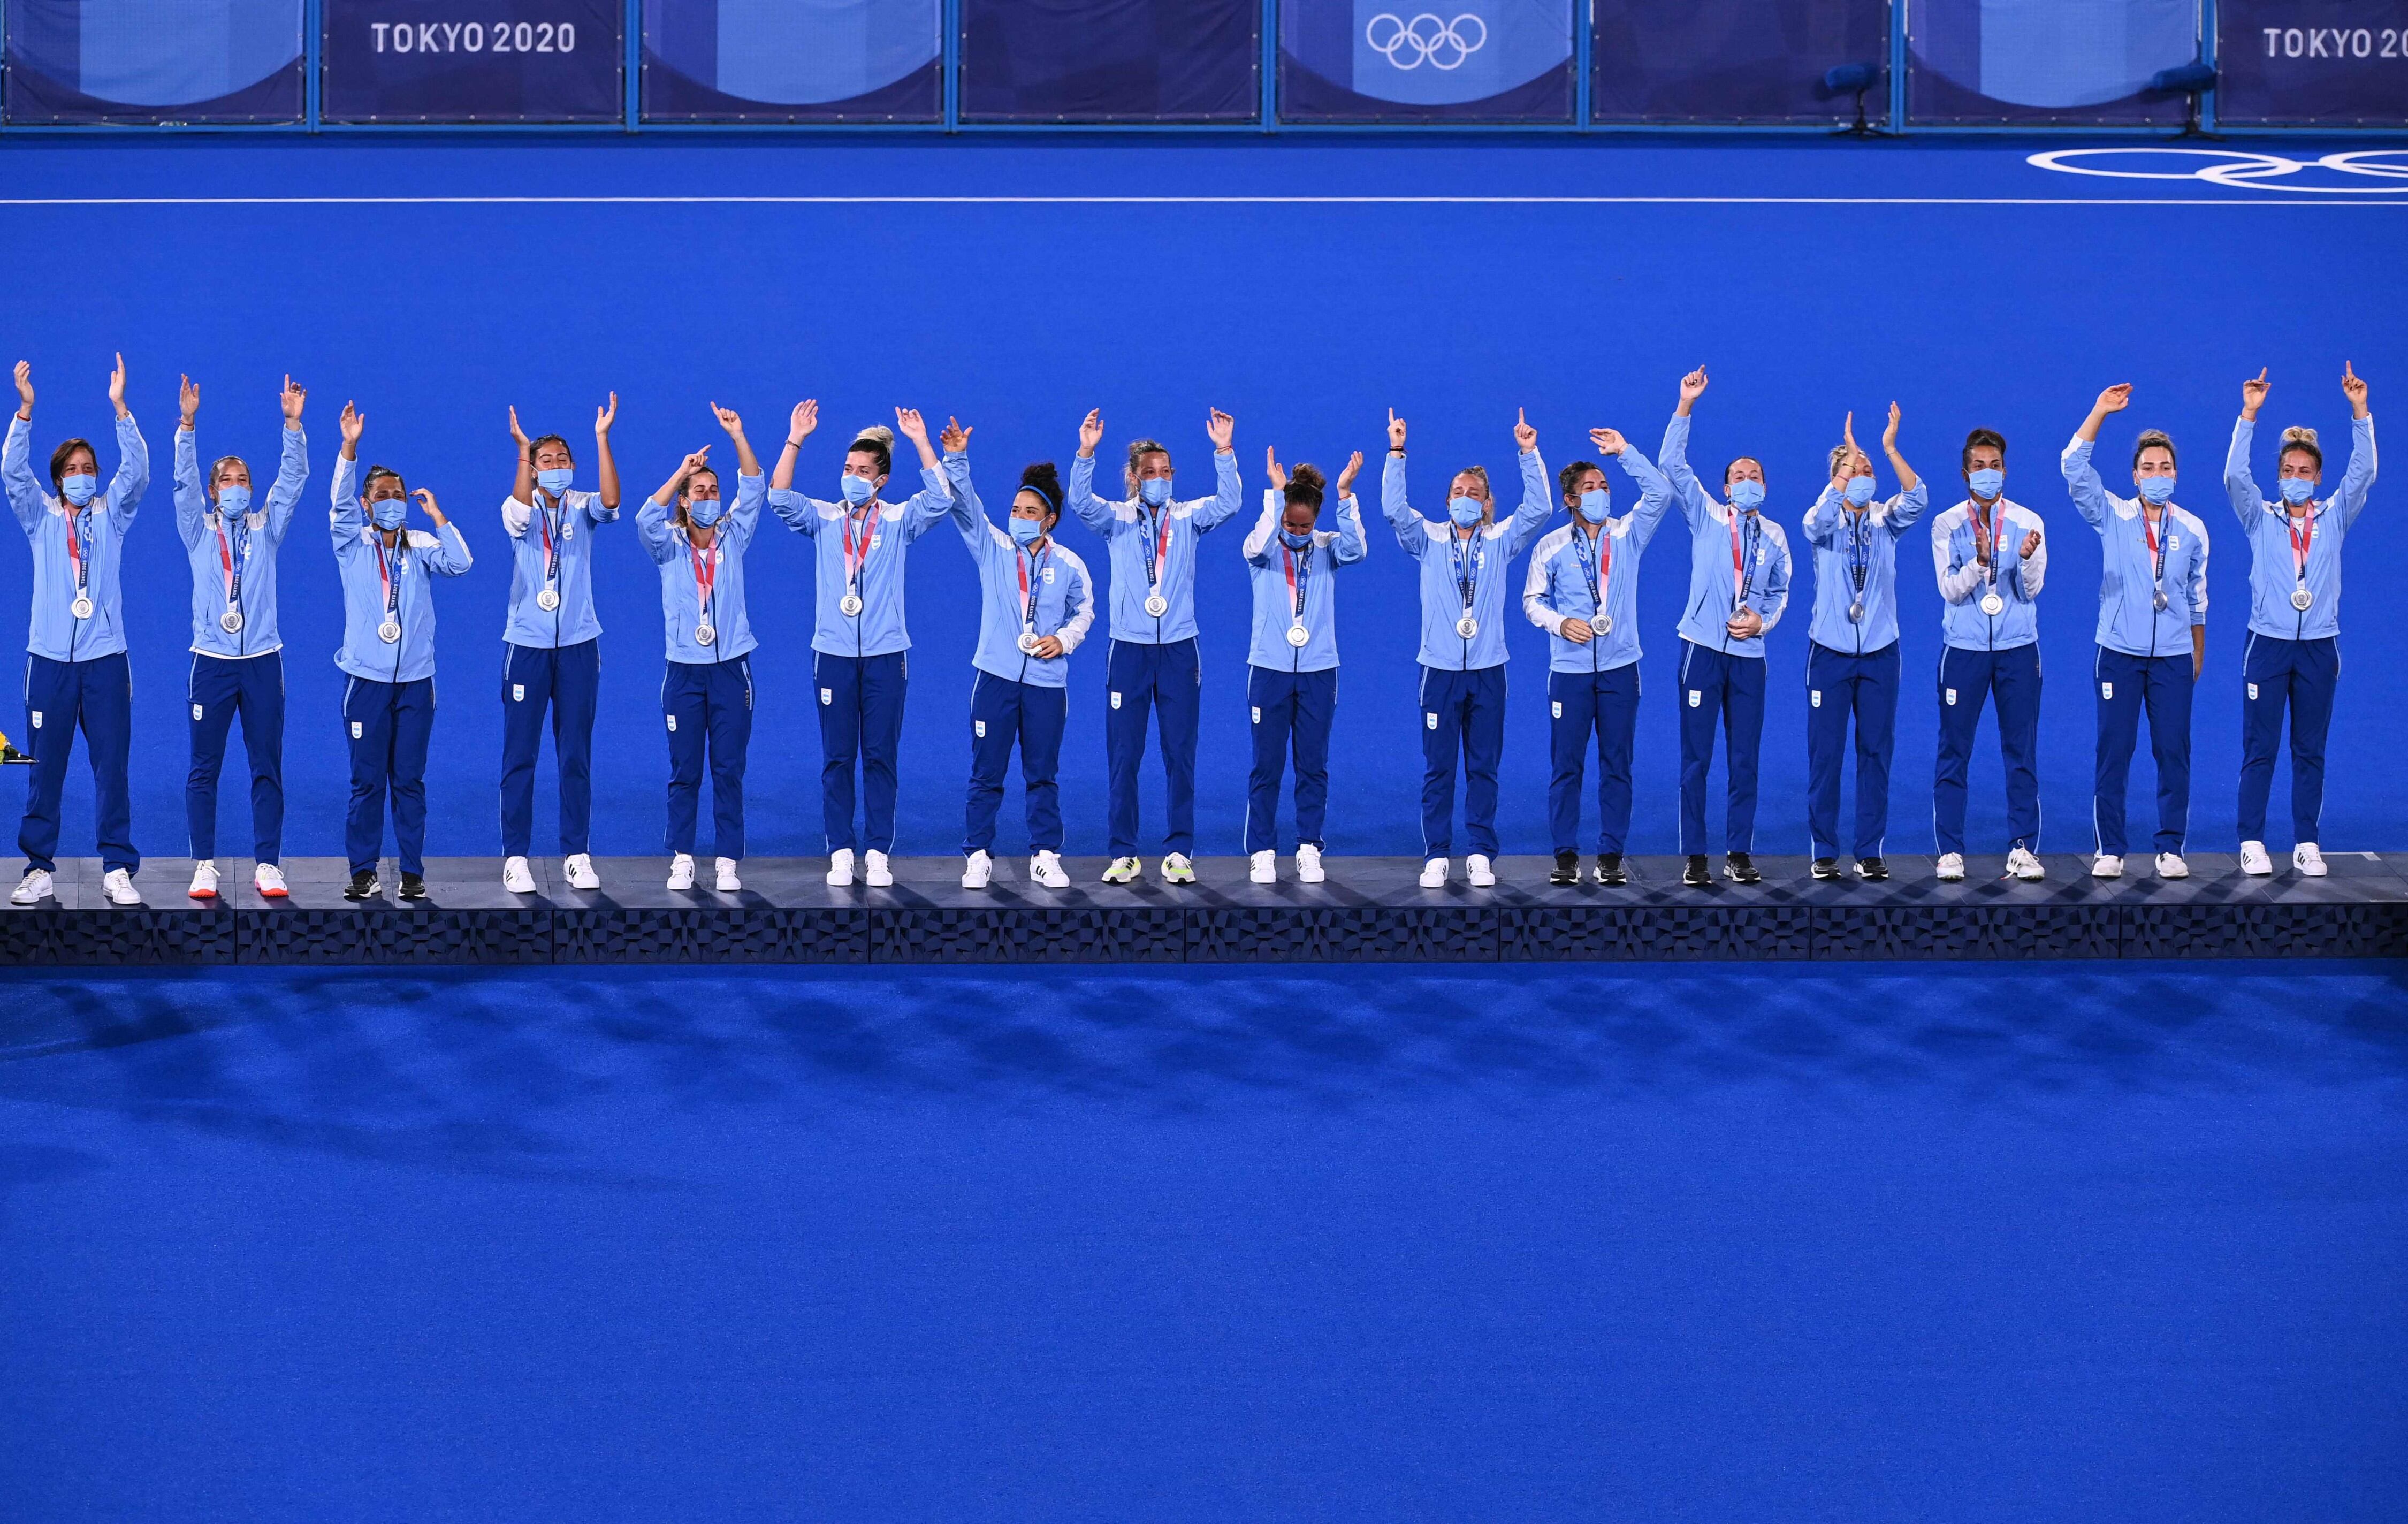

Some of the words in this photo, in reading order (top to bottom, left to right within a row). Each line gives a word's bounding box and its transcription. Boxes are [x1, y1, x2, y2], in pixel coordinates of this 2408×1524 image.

[371, 23, 483, 53] TOKYO
[493, 22, 575, 52] 2020
[2263, 28, 2371, 58] TOKYO
